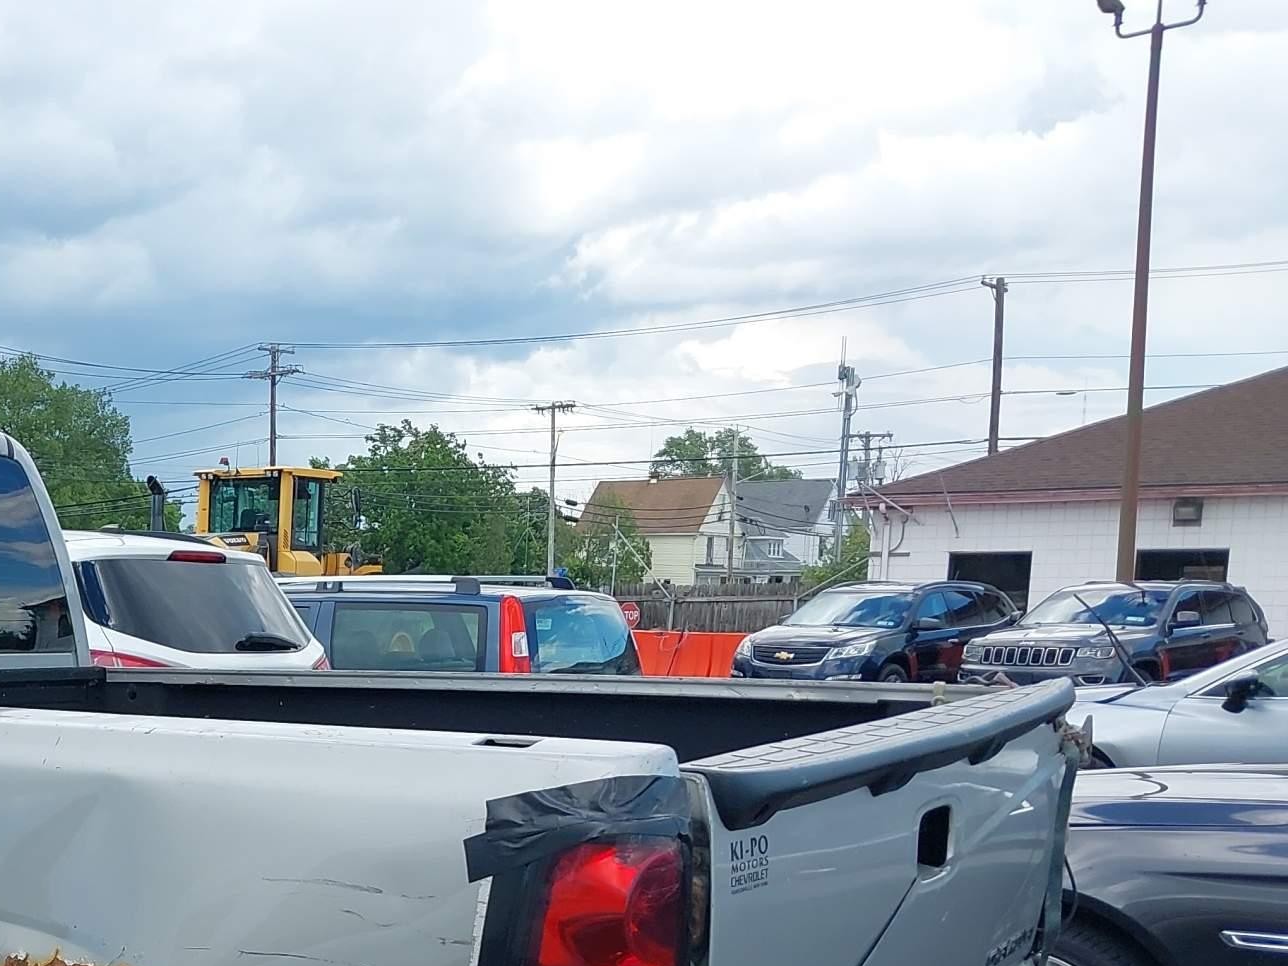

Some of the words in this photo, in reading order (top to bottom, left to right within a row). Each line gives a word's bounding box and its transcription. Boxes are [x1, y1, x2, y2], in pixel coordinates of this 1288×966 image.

[623, 610, 639, 621] TOP
[730, 834, 769, 862] KI-PO
[731, 855, 769, 875] MOTORS
[731, 868, 769, 888] CHEVROLET
